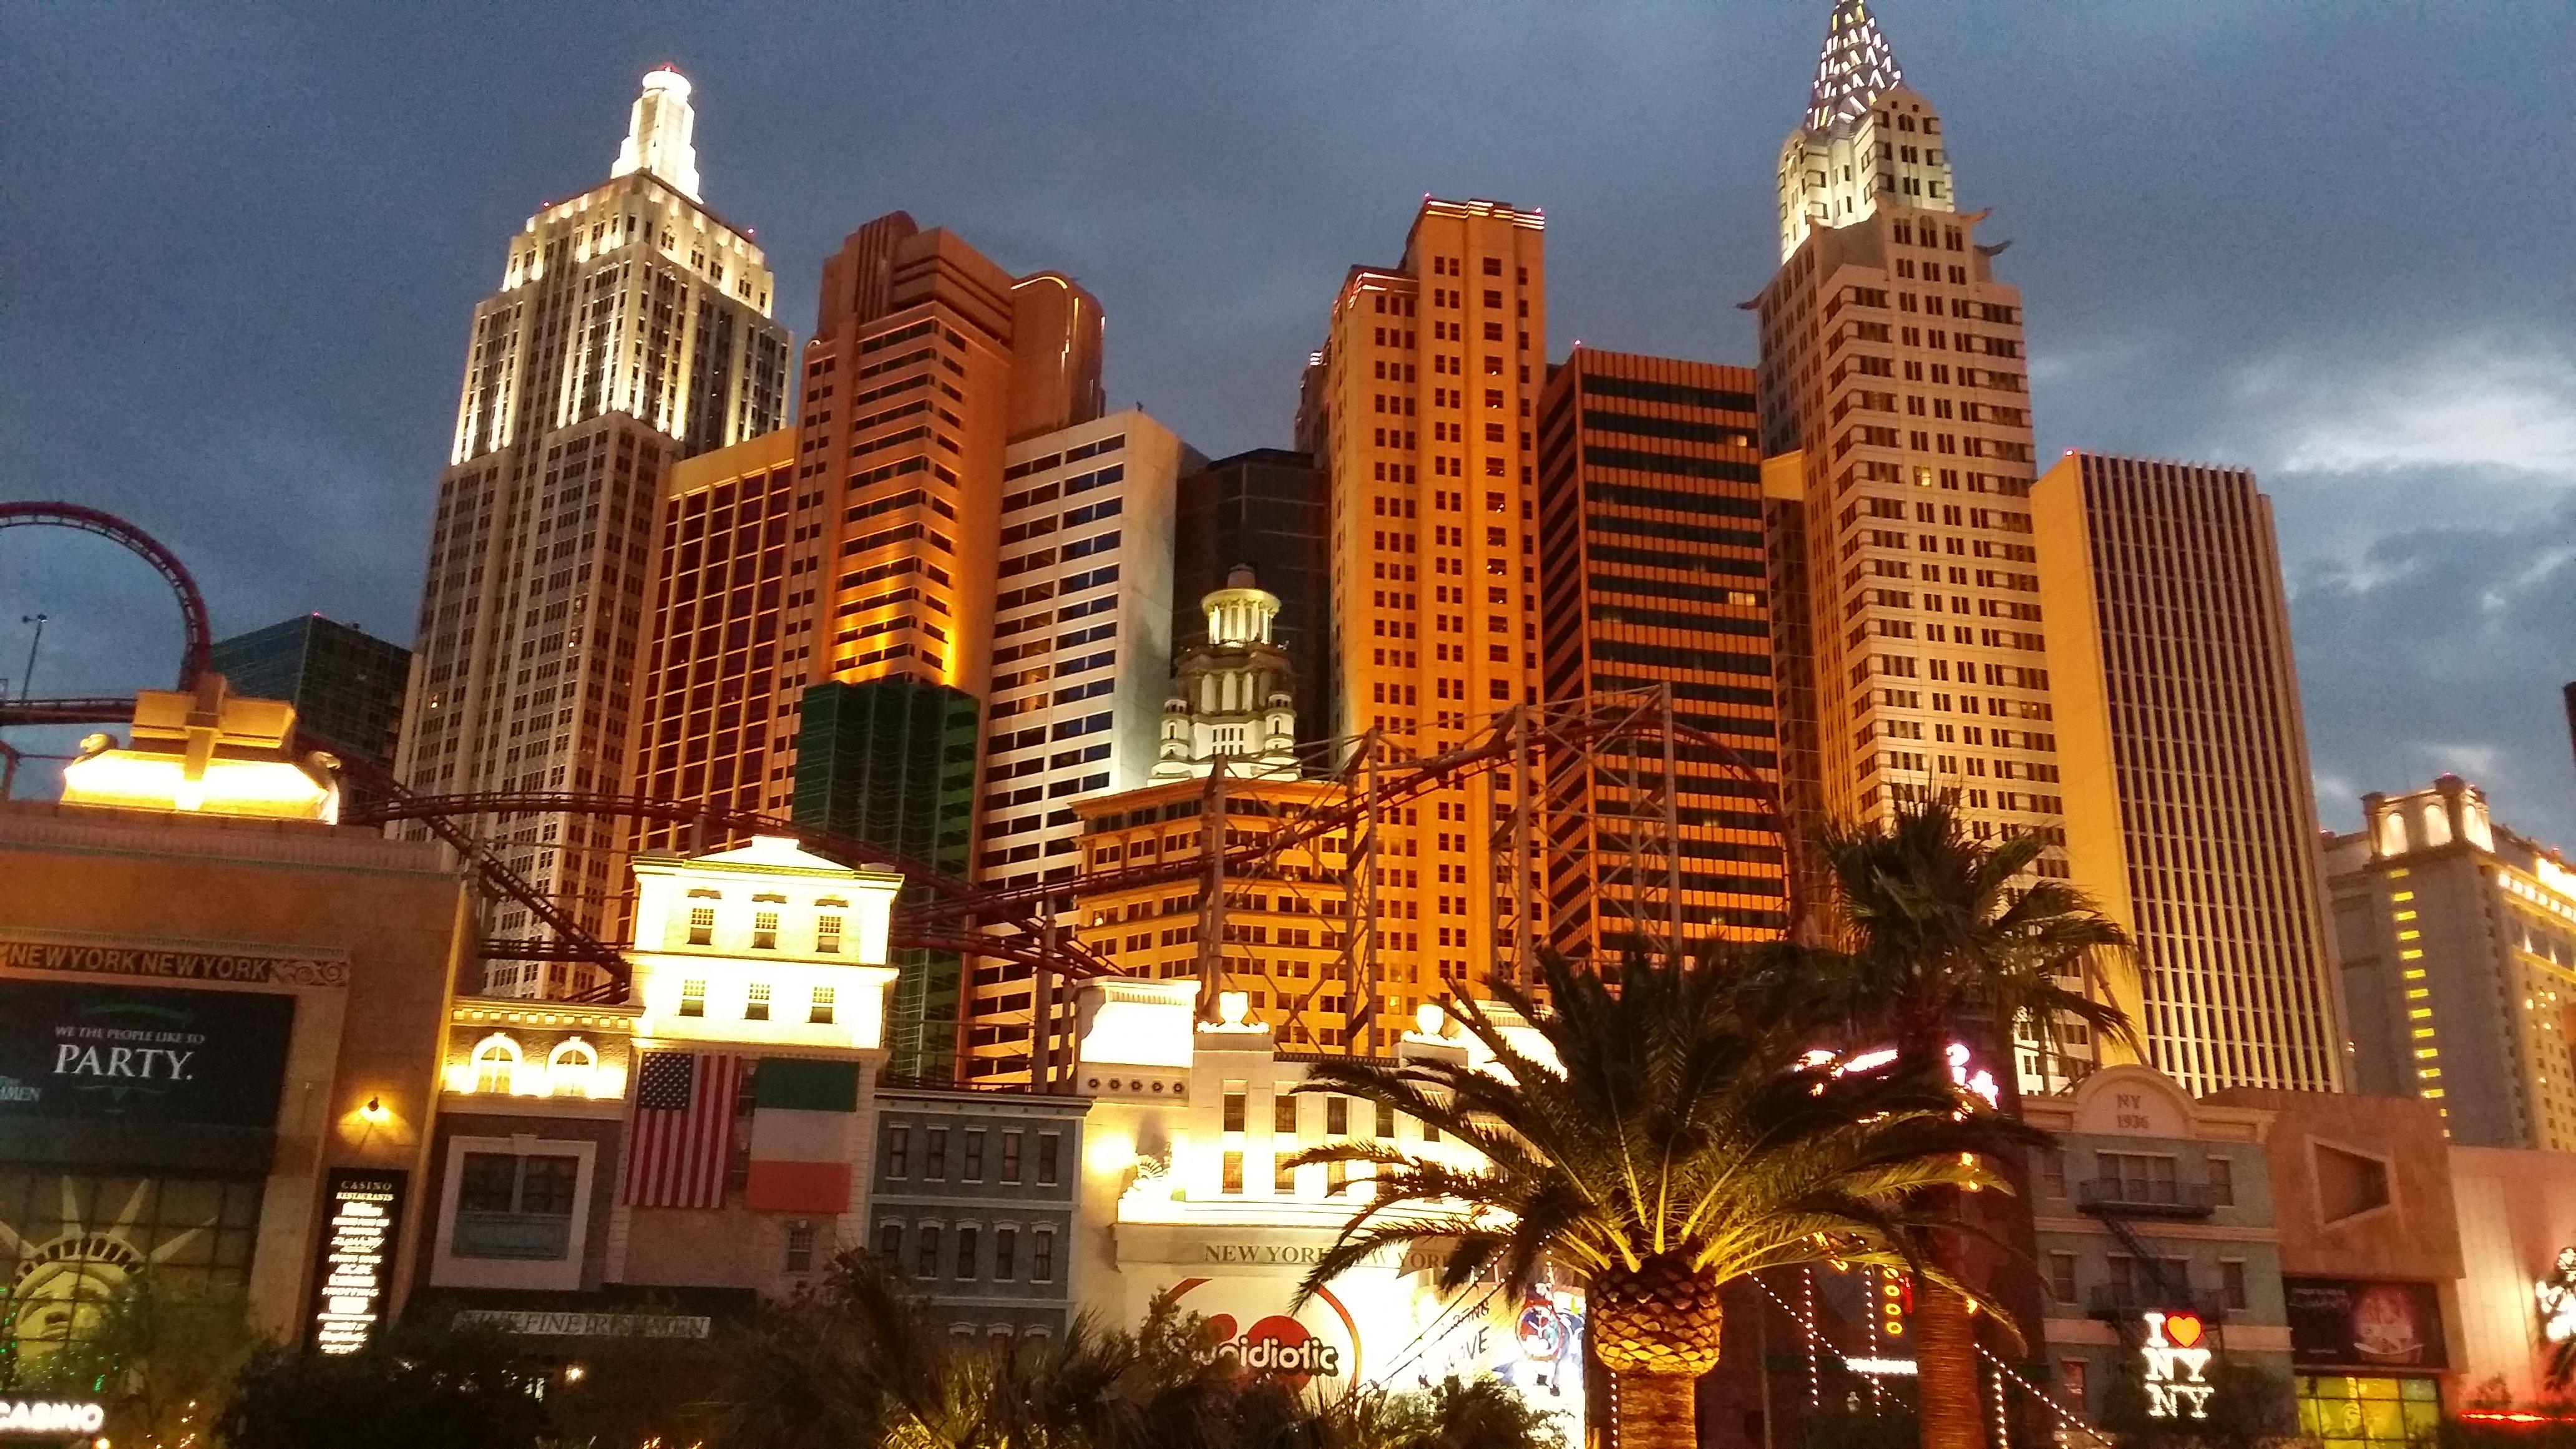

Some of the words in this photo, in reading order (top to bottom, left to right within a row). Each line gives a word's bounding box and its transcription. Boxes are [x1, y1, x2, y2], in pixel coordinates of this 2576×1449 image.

[79, 1027, 102, 1038] THE
[107, 1029, 152, 1041] PEOPLE
[54, 1043, 195, 1080] PARTY.
[2117, 1095, 2140, 1109] NY
[341, 1181, 393, 1191] CASINO
[1205, 1244, 1261, 1262] NEW
[1397, 1252, 1449, 1269] YOR
[2144, 1312, 2169, 1347] I
[2141, 1347, 2212, 1382] NY
[2144, 1383, 2215, 1418] NY
